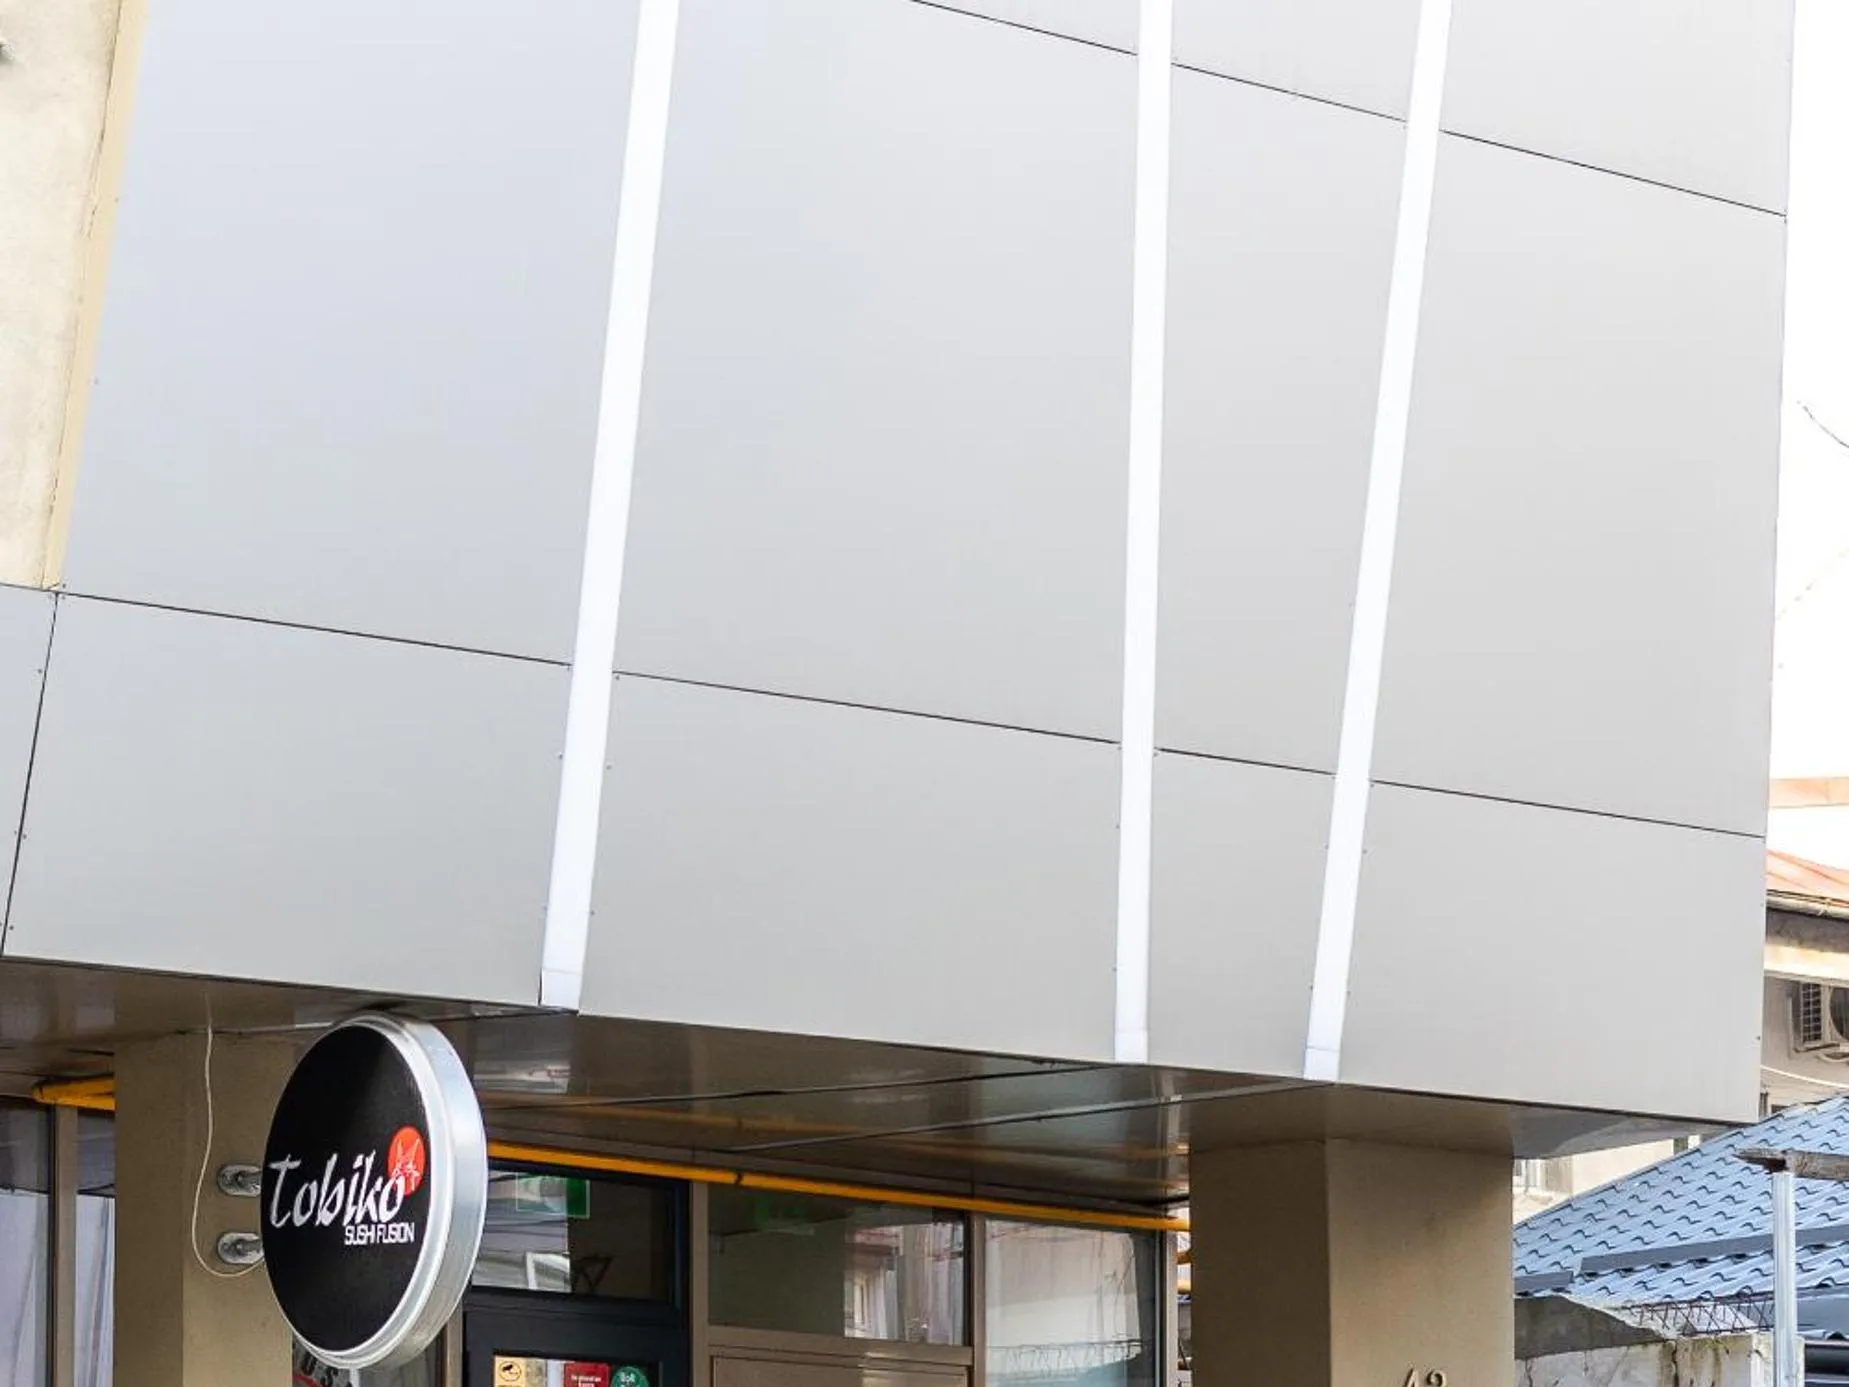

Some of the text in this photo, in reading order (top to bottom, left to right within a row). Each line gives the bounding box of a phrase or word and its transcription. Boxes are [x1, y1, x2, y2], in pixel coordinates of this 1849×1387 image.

[267, 1149, 406, 1229] Tobiko
[344, 1222, 415, 1246] SUSHI FUSION
